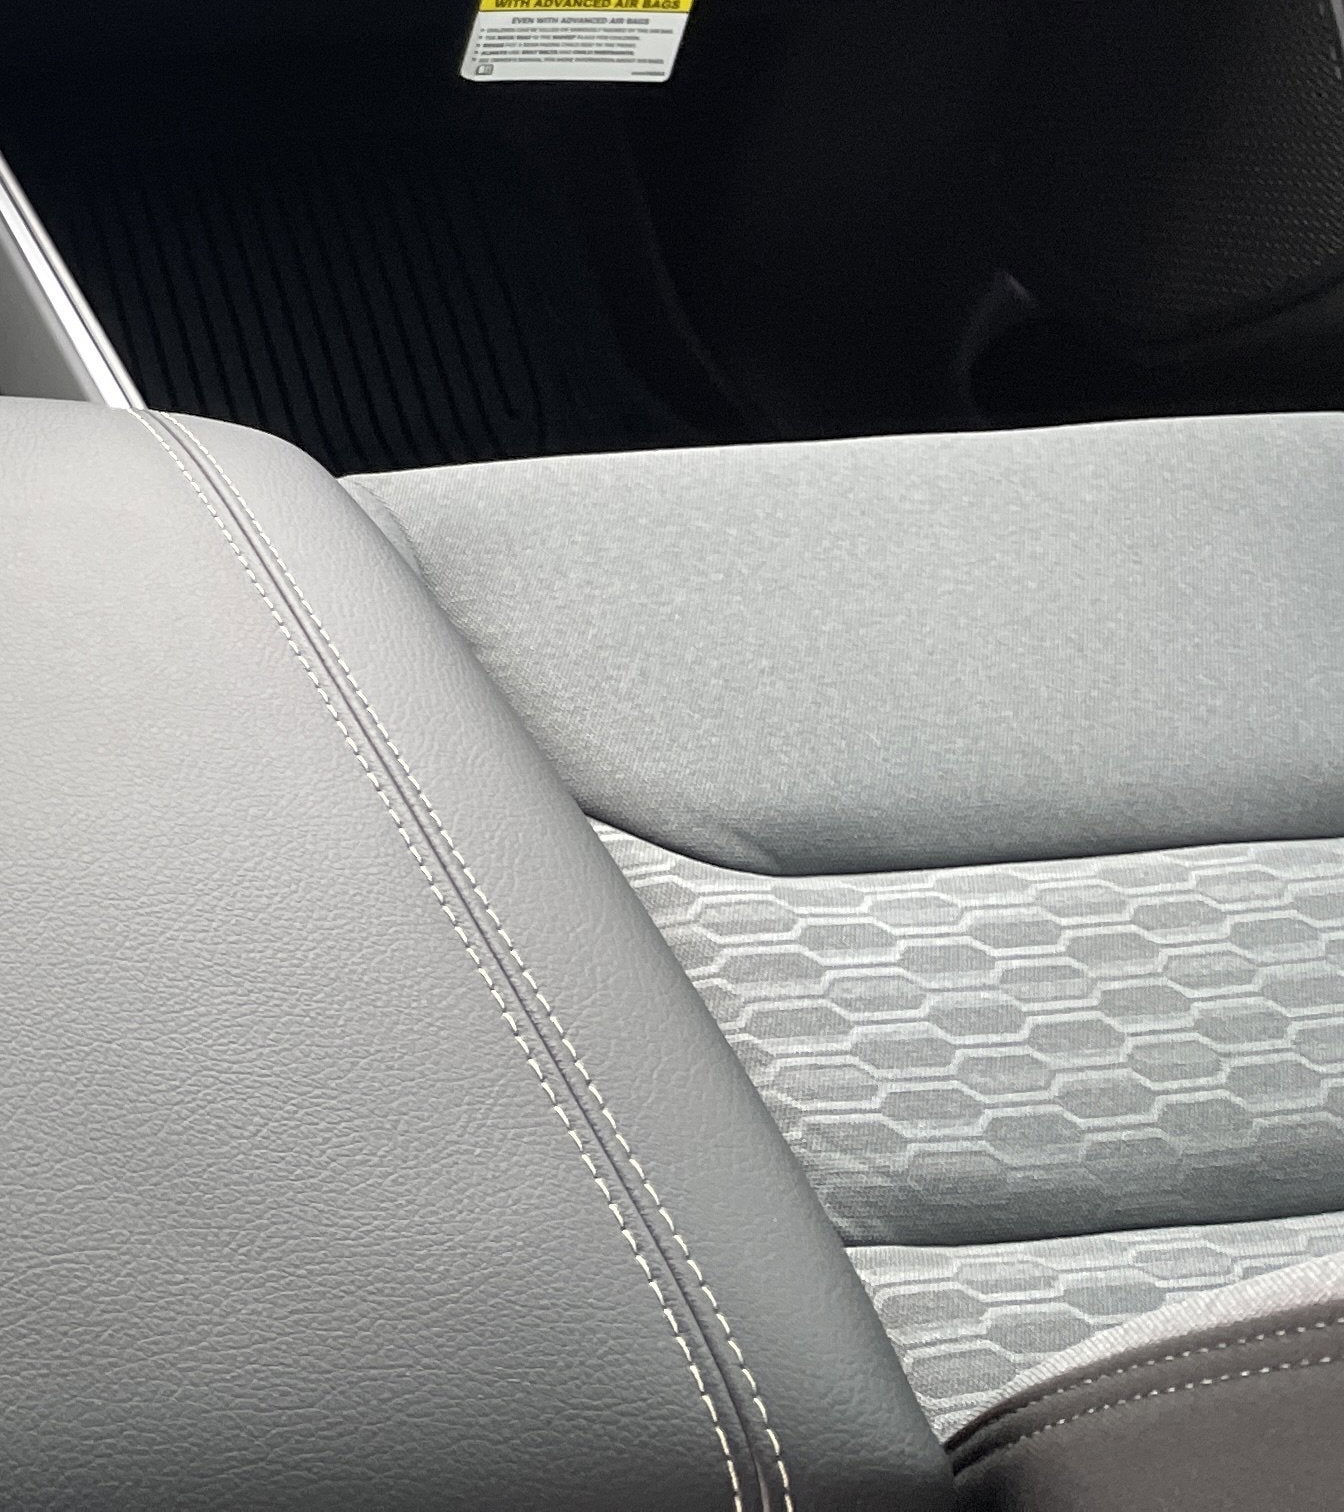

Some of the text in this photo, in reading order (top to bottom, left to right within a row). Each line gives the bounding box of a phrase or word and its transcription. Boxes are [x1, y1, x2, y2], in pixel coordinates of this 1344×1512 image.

[614, 0, 637, 9] AIR
[641, 0, 681, 10] BAGS
[511, 17, 534, 25] EVEN
[536, 17, 559, 25] WITH
[561, 17, 608, 26] ADVANCED
[609, 17, 625, 26] AIR
